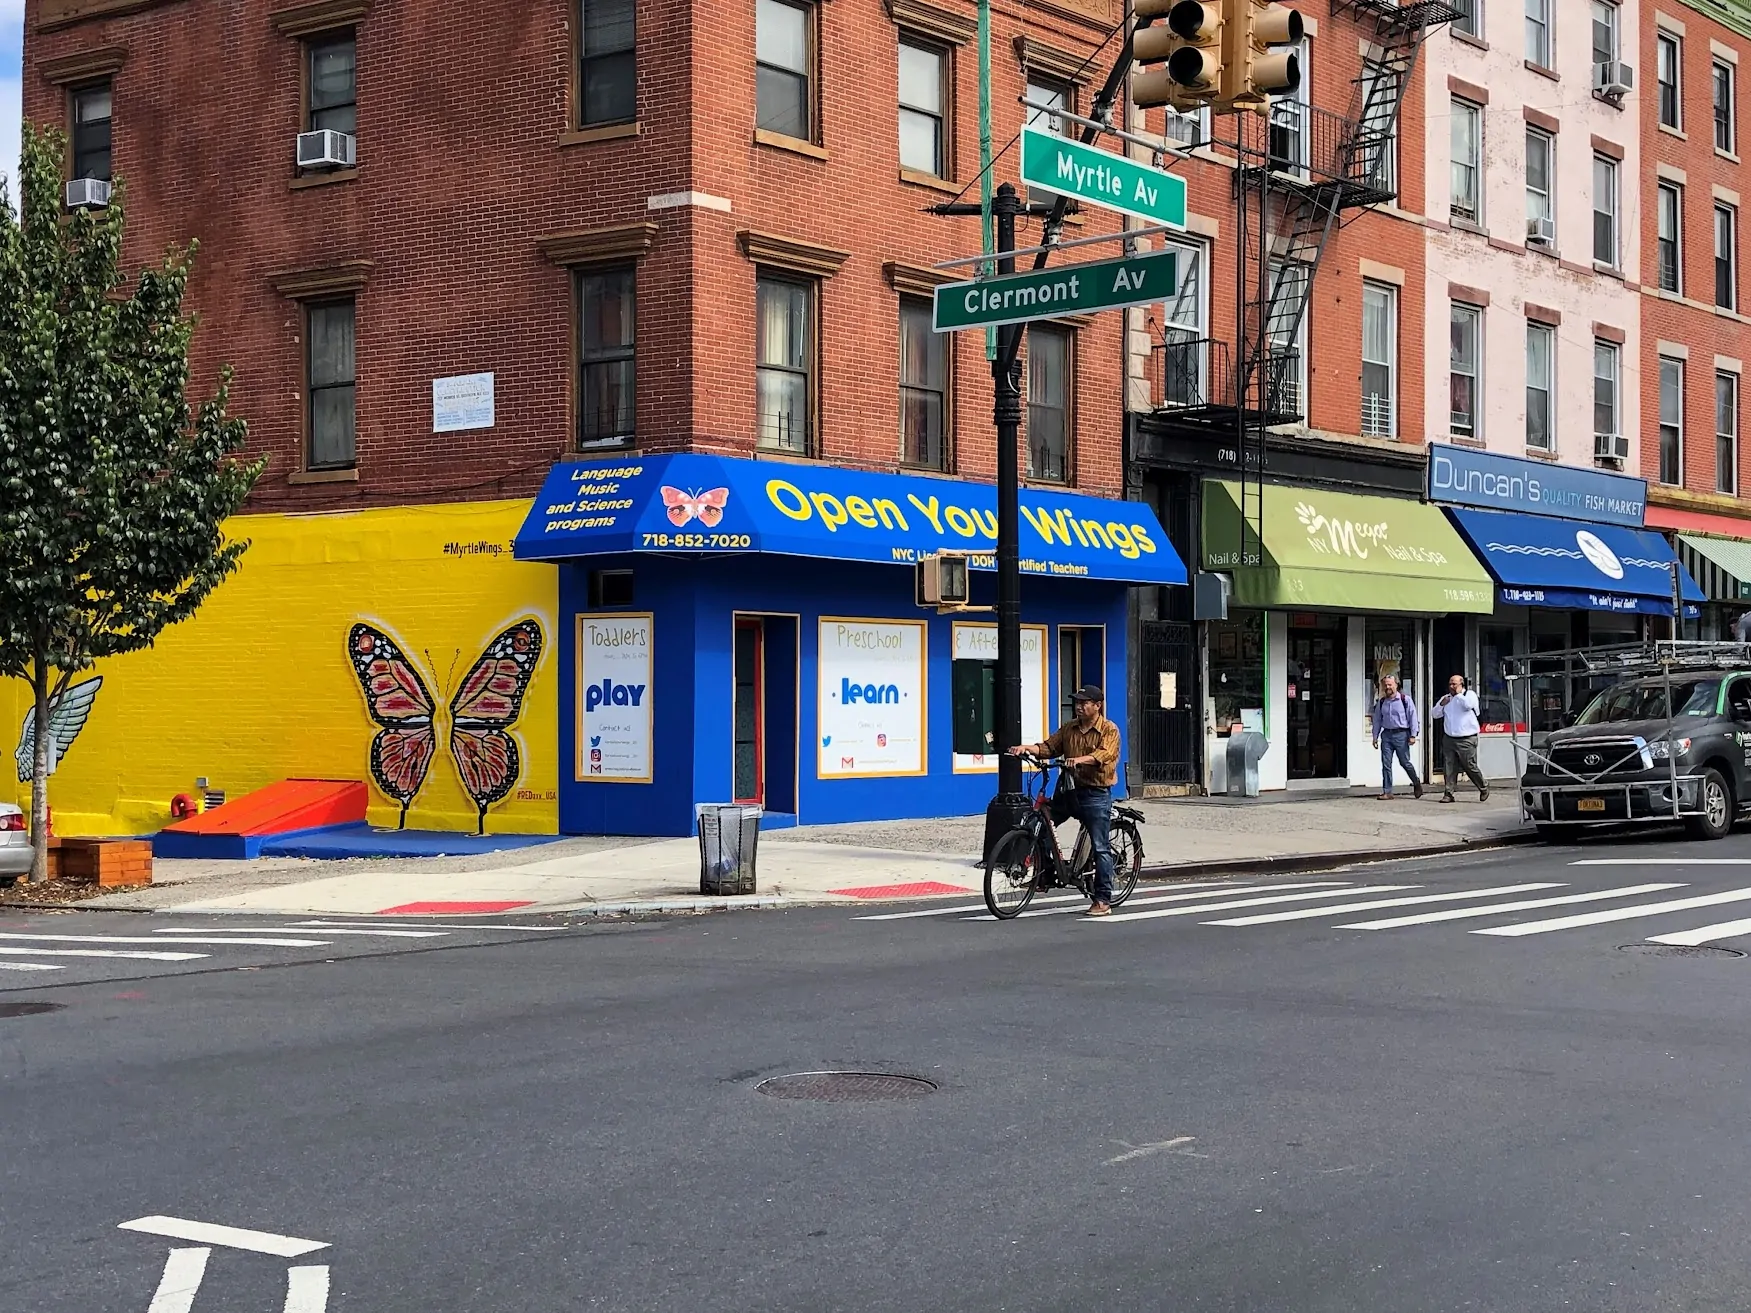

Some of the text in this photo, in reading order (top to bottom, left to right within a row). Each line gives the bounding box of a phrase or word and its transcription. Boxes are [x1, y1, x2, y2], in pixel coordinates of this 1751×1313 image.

[1057, 151, 1158, 207] Myrtle Av
[964, 267, 1146, 313] Clermont Av
[1218, 449, 1236, 463] (718)
[571, 465, 643, 481] Language
[577, 482, 620, 497] Music
[1433, 456, 1643, 516] Duncan's QUALITY FISH MARKET
[545, 498, 633, 515] and Science
[545, 515, 616, 533] programs
[765, 479, 1158, 559] Open You Wings
[642, 534, 751, 548] 718-852-7020
[1306, 537, 1331, 554] NY
[892, 547, 915, 562] NYC
[972, 555, 995, 568] DOH
[1019, 559, 1047, 572] rtified
[1048, 561, 1089, 575] Teachers
[1209, 552, 1229, 564] Nail
[1231, 552, 1240, 564] &
[1383, 544, 1448, 567] Nail & Spa
[588, 625, 646, 647] Toddlers
[837, 624, 902, 649] Preschool
[1374, 644, 1402, 660] NAILS
[586, 679, 646, 712] play
[841, 677, 899, 705] learn
